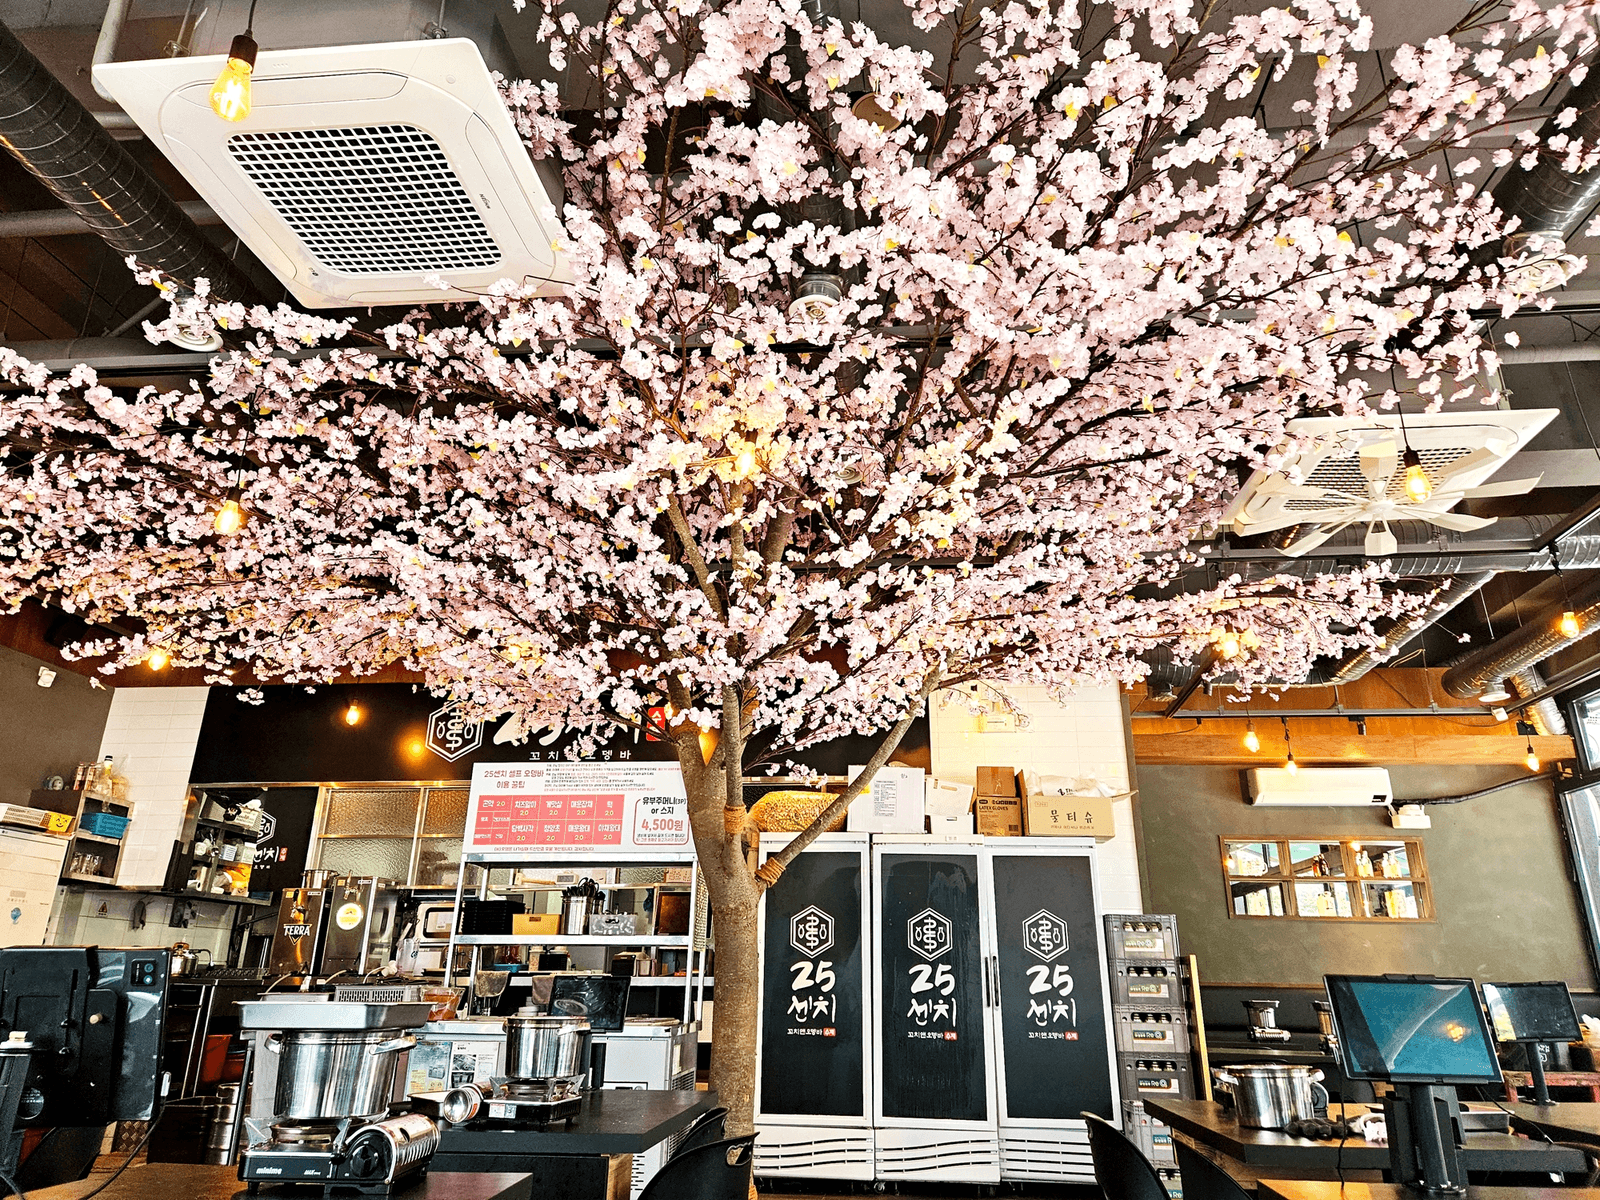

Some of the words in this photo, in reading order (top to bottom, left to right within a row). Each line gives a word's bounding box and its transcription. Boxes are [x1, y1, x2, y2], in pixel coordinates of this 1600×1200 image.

[529, 750, 632, 761] 꼬치뎅바
[484, 770, 507, 778] 25센치
[524, 769, 544, 777] 오뎅바
[660, 806, 674, 814] 스지
[1050, 809, 1094, 824] 물티슈
[641, 818, 684, 832] 4,500원
[284, 925, 311, 936] TERRA
[790, 960, 836, 993] 25
[908, 963, 956, 996] 25
[1026, 964, 1074, 997] 25
[787, 994, 837, 1024] 센치
[907, 997, 957, 1028] 센치
[1026, 998, 1077, 1028] 센치
